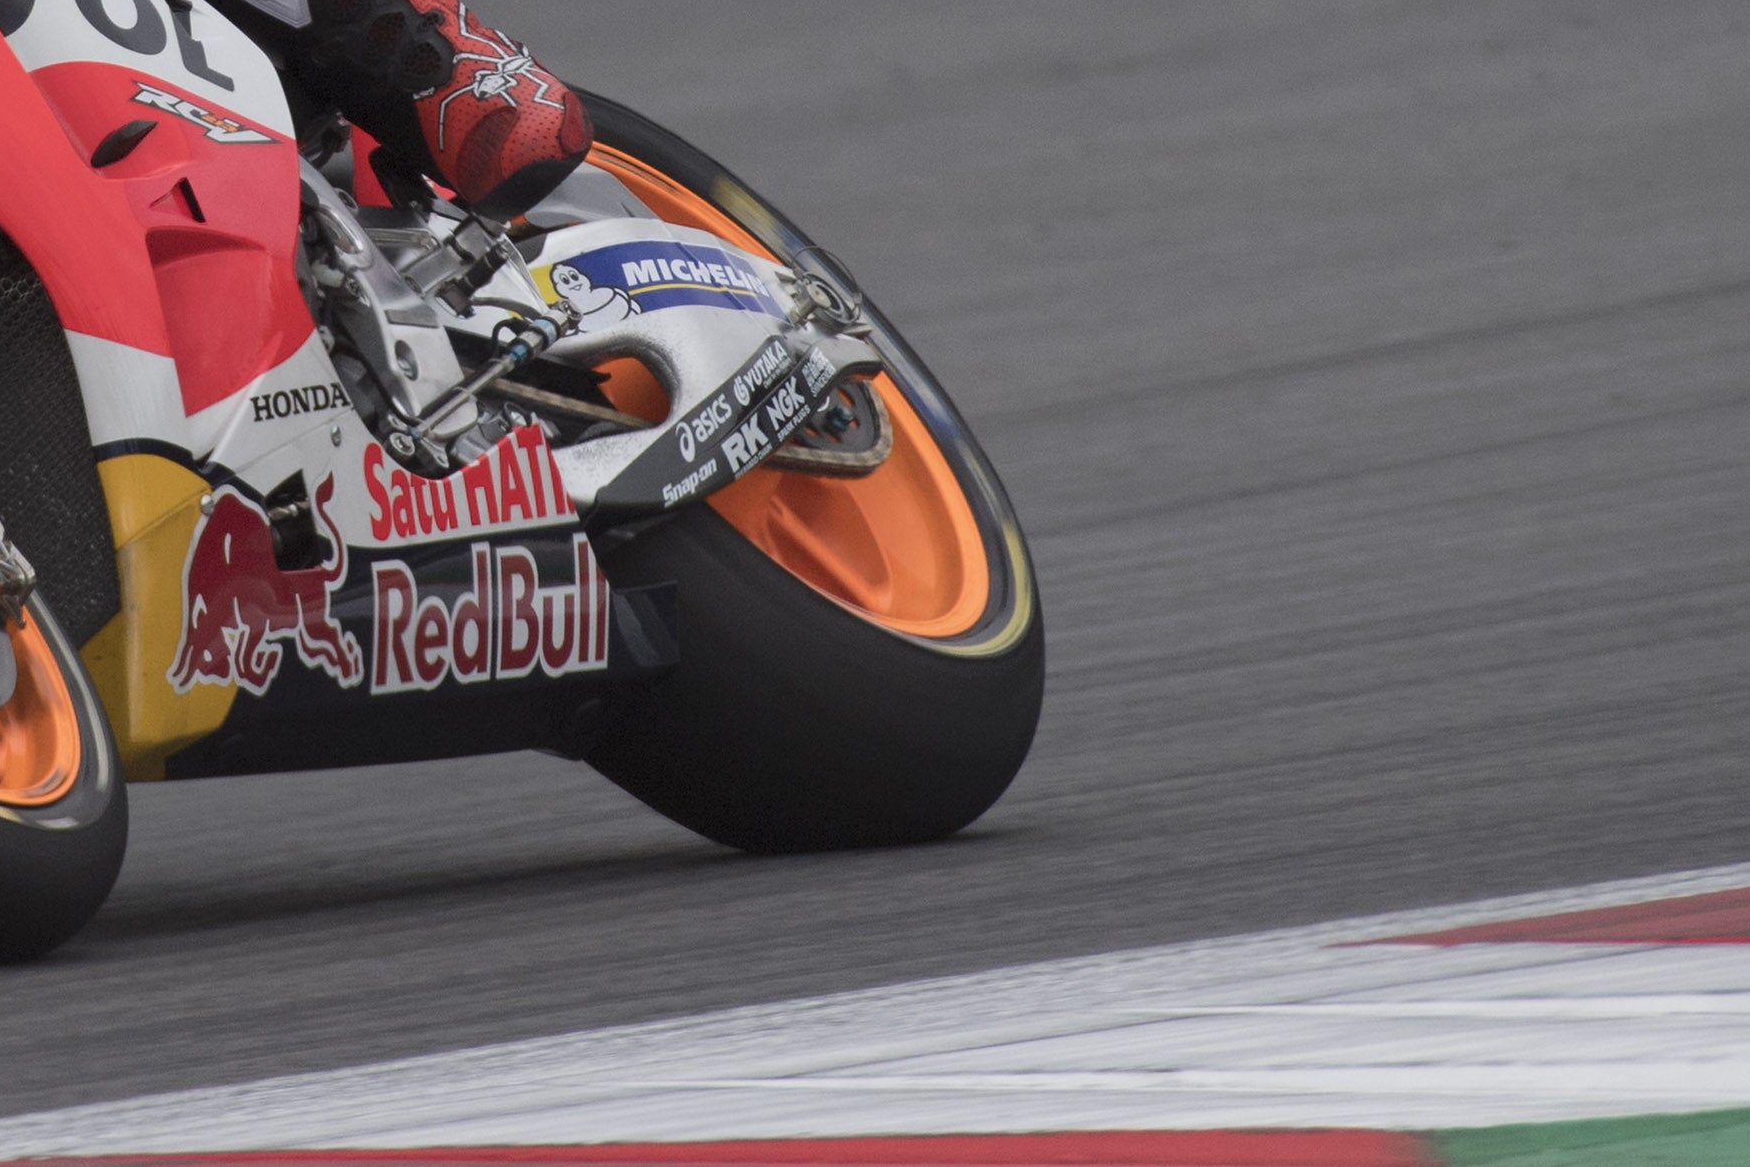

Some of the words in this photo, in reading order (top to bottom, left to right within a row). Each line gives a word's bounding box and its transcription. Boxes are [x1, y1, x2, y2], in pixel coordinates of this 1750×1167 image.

[621, 258, 770, 297] MICHELIN
[743, 340, 788, 392] YUTAKA
[250, 382, 351, 422] HONDA
[765, 376, 806, 431] NGK
[721, 411, 770, 474] RK
[363, 442, 459, 542] Satu
[662, 458, 718, 509] Snap-on
[371, 542, 492, 695] Red
[496, 532, 609, 681] Bull
